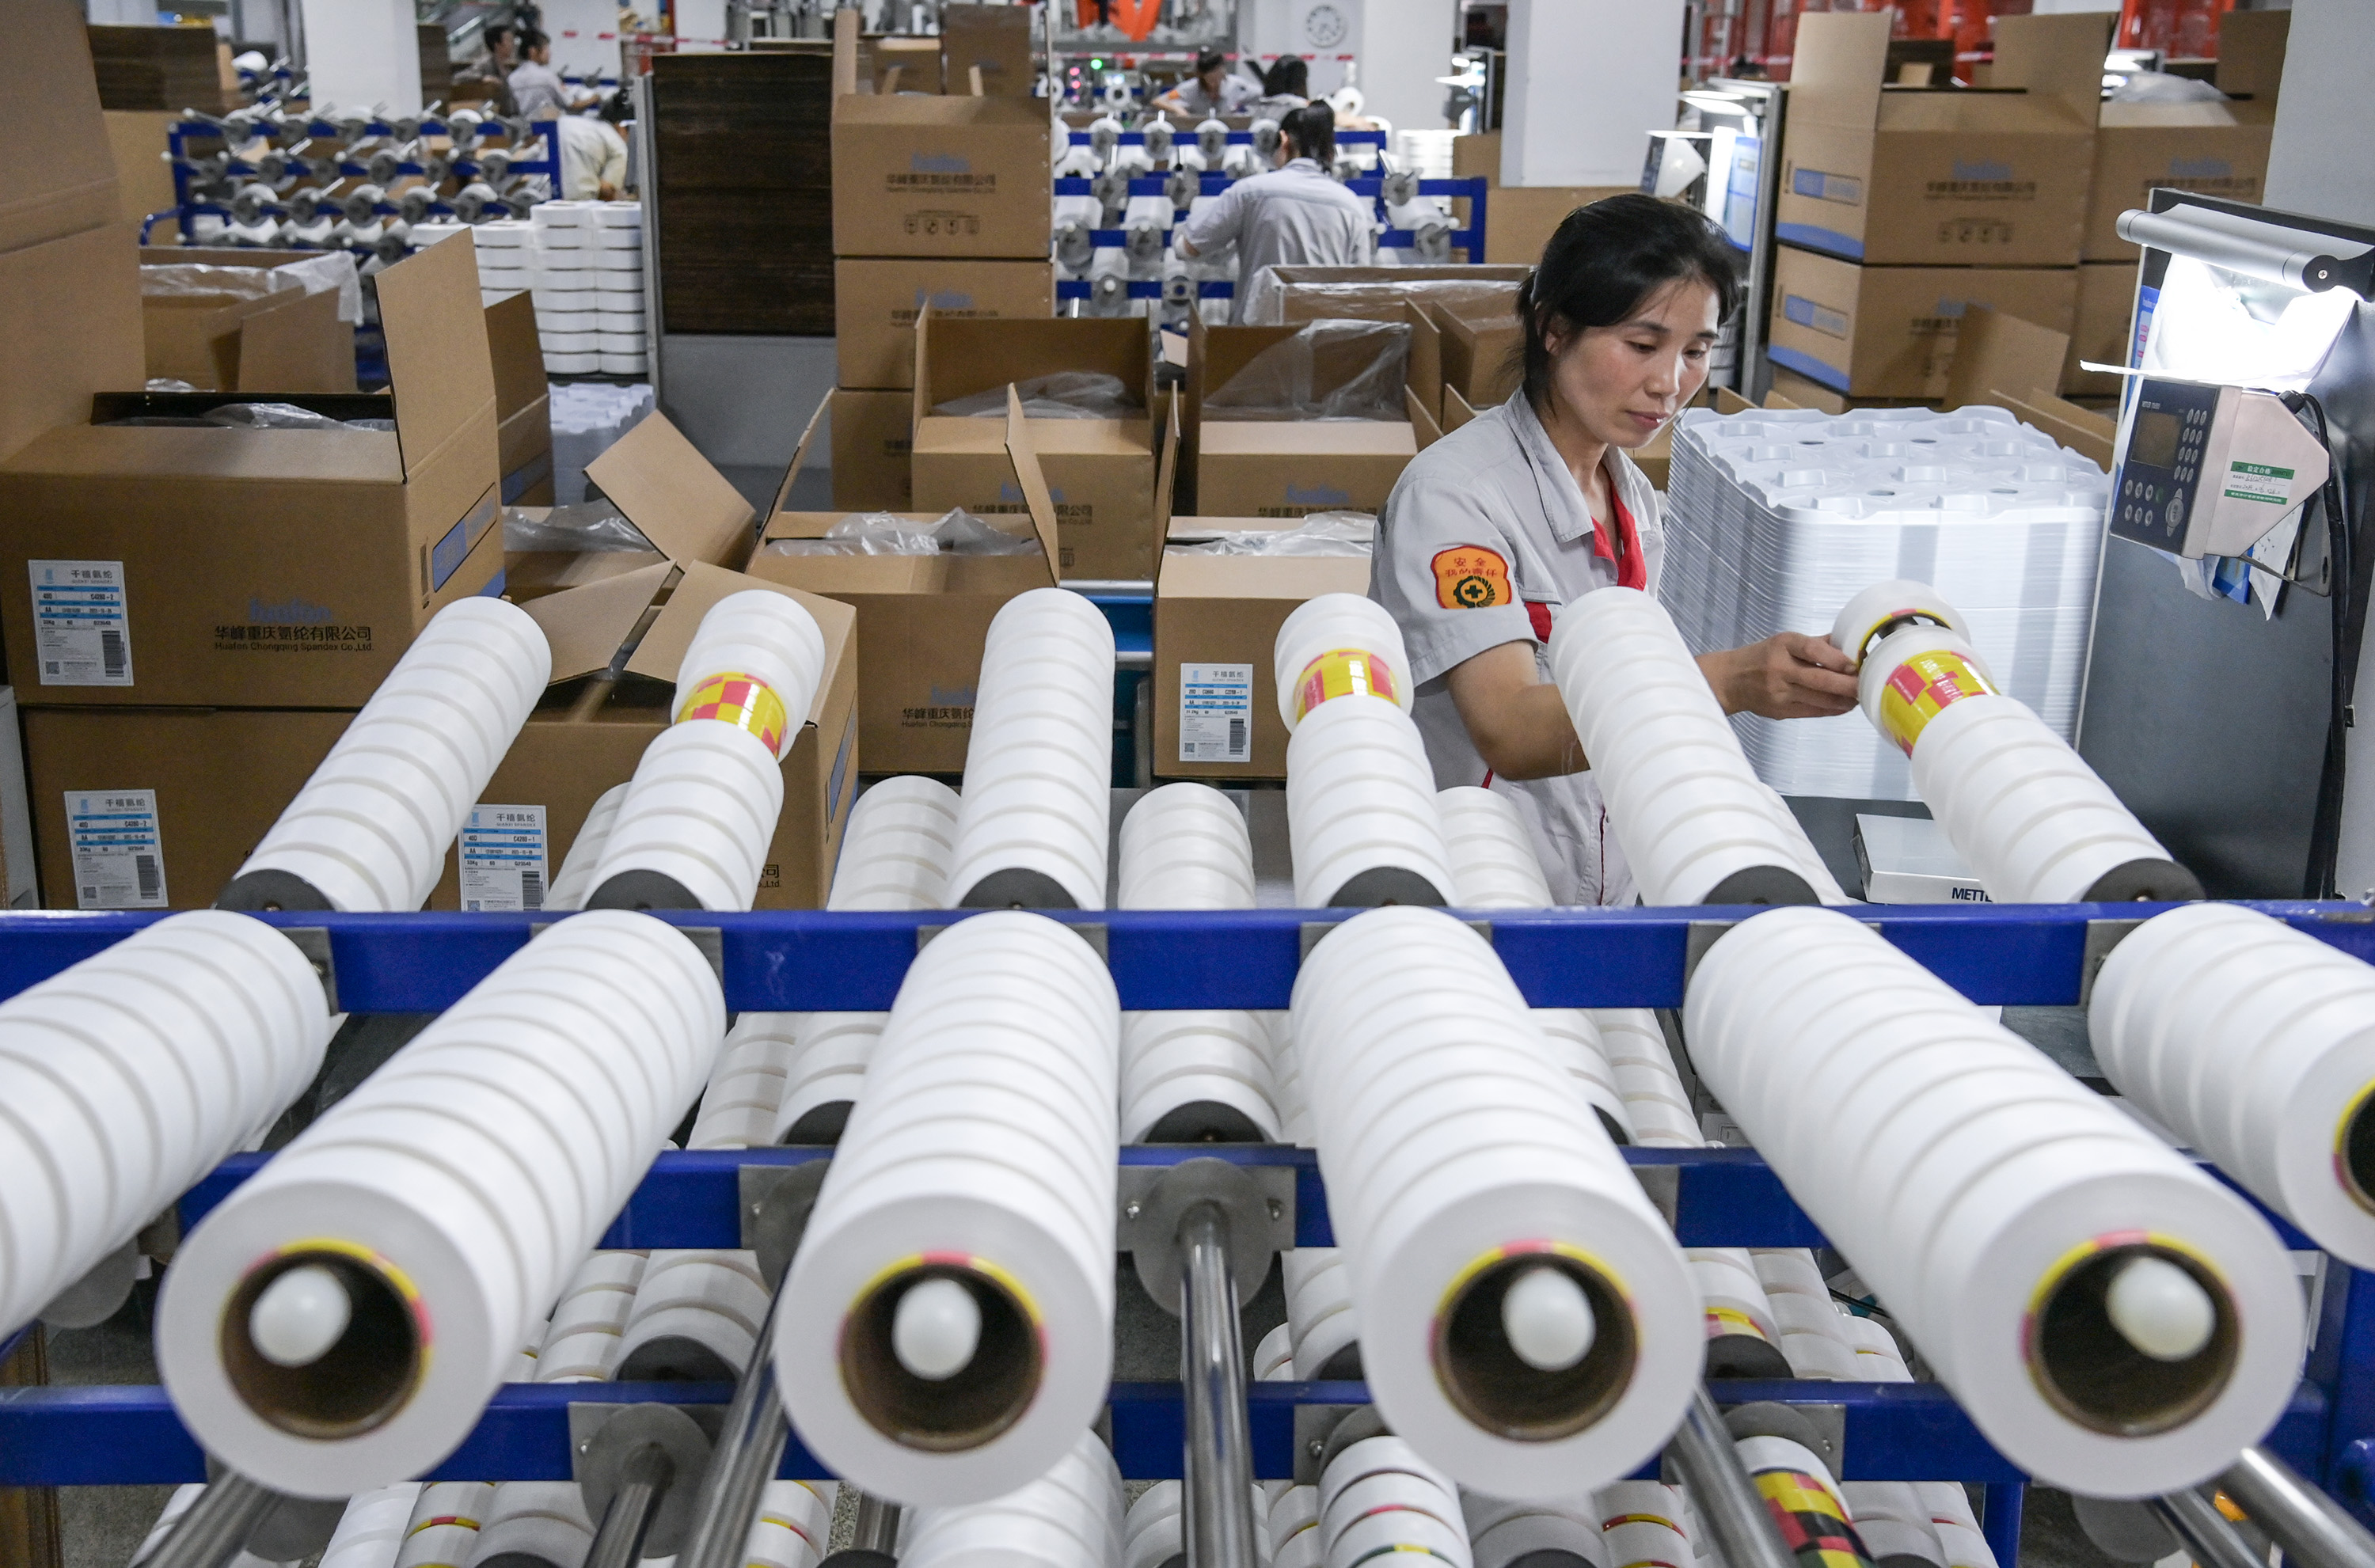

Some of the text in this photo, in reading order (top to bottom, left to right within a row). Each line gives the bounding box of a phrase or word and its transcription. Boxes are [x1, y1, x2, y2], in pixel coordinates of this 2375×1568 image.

[215, 626, 371, 641] 华峰重庆氨纶有限公司
[251, 643, 298, 652] Chongqing
[301, 643, 337, 651] Spandex
[497, 814, 535, 822] 千禧氨纶
